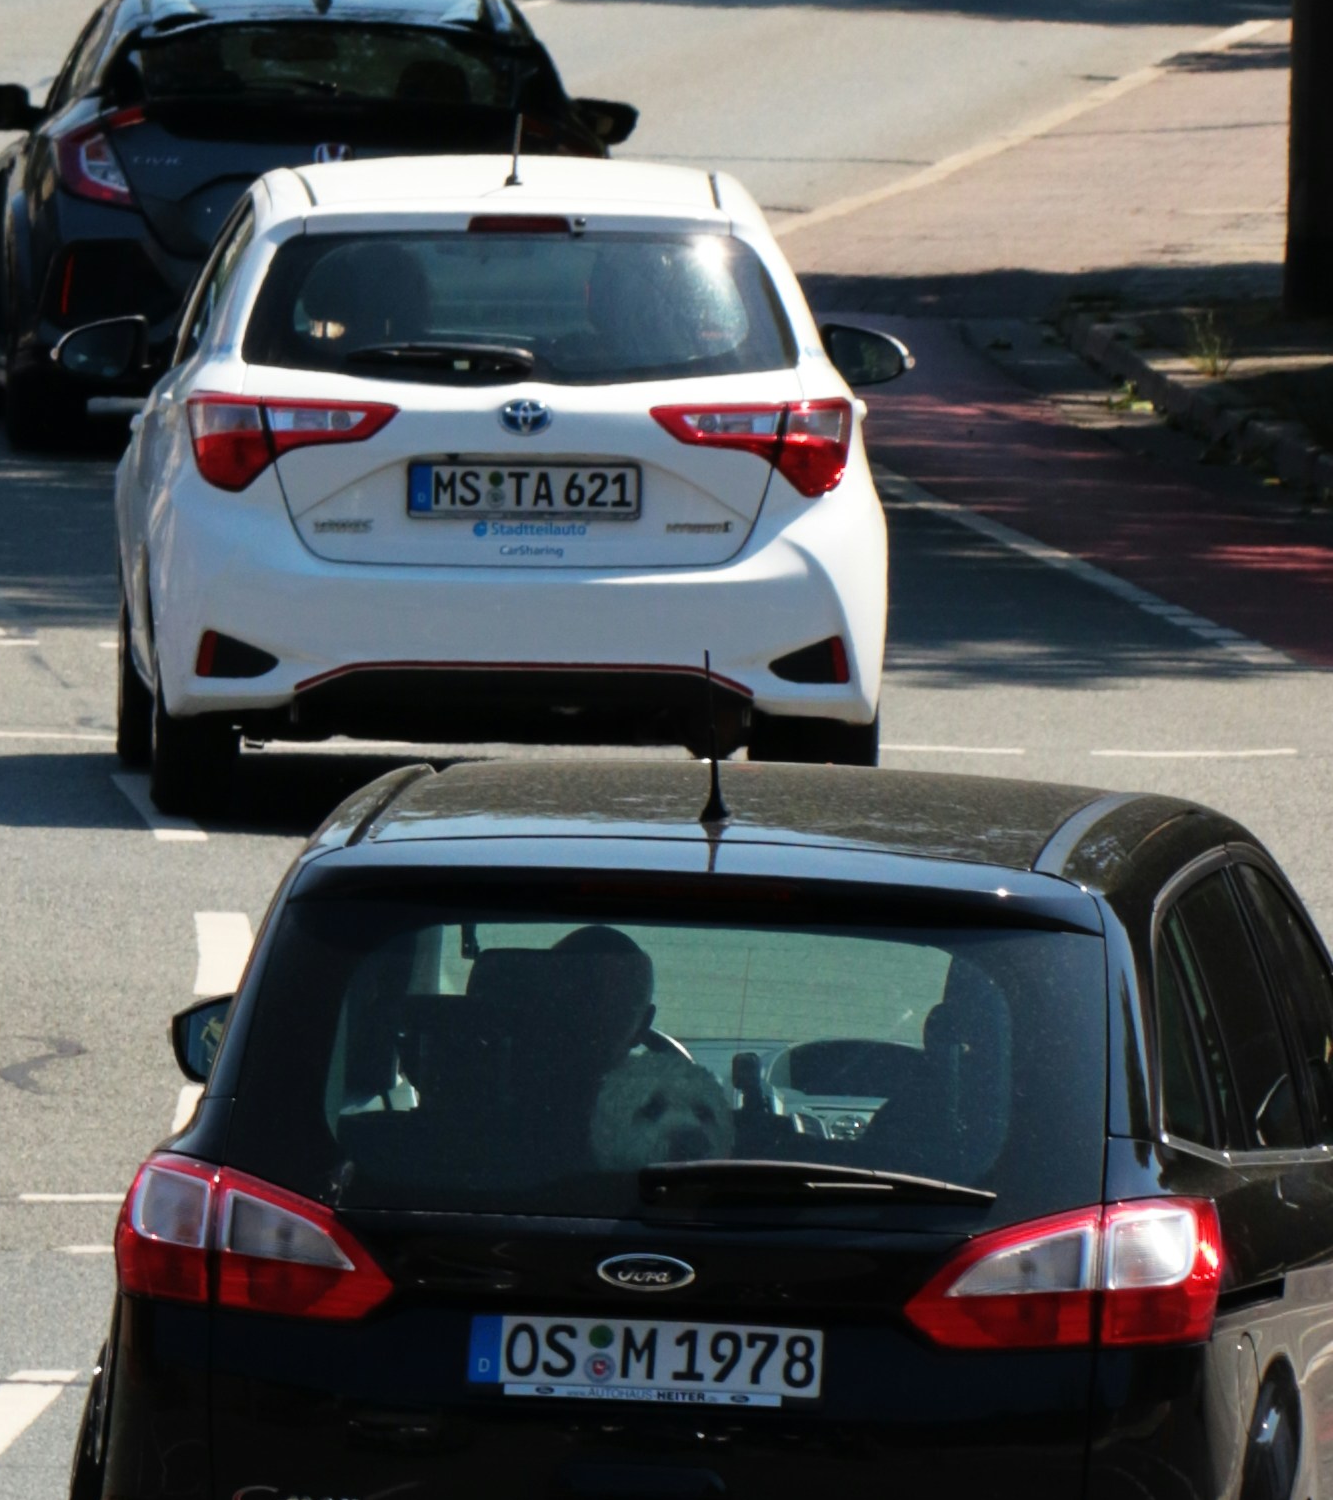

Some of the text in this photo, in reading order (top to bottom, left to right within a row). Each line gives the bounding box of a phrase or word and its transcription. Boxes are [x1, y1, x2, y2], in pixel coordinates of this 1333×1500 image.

[433, 470, 481, 507] MS
[507, 471, 554, 507] TA
[563, 472, 633, 508] 621
[491, 522, 588, 536] Stadtteilauto
[499, 544, 564, 558] CarSharing
[505, 1322, 578, 1378] OS
[620, 1326, 659, 1381] M
[671, 1328, 816, 1389] 1978
